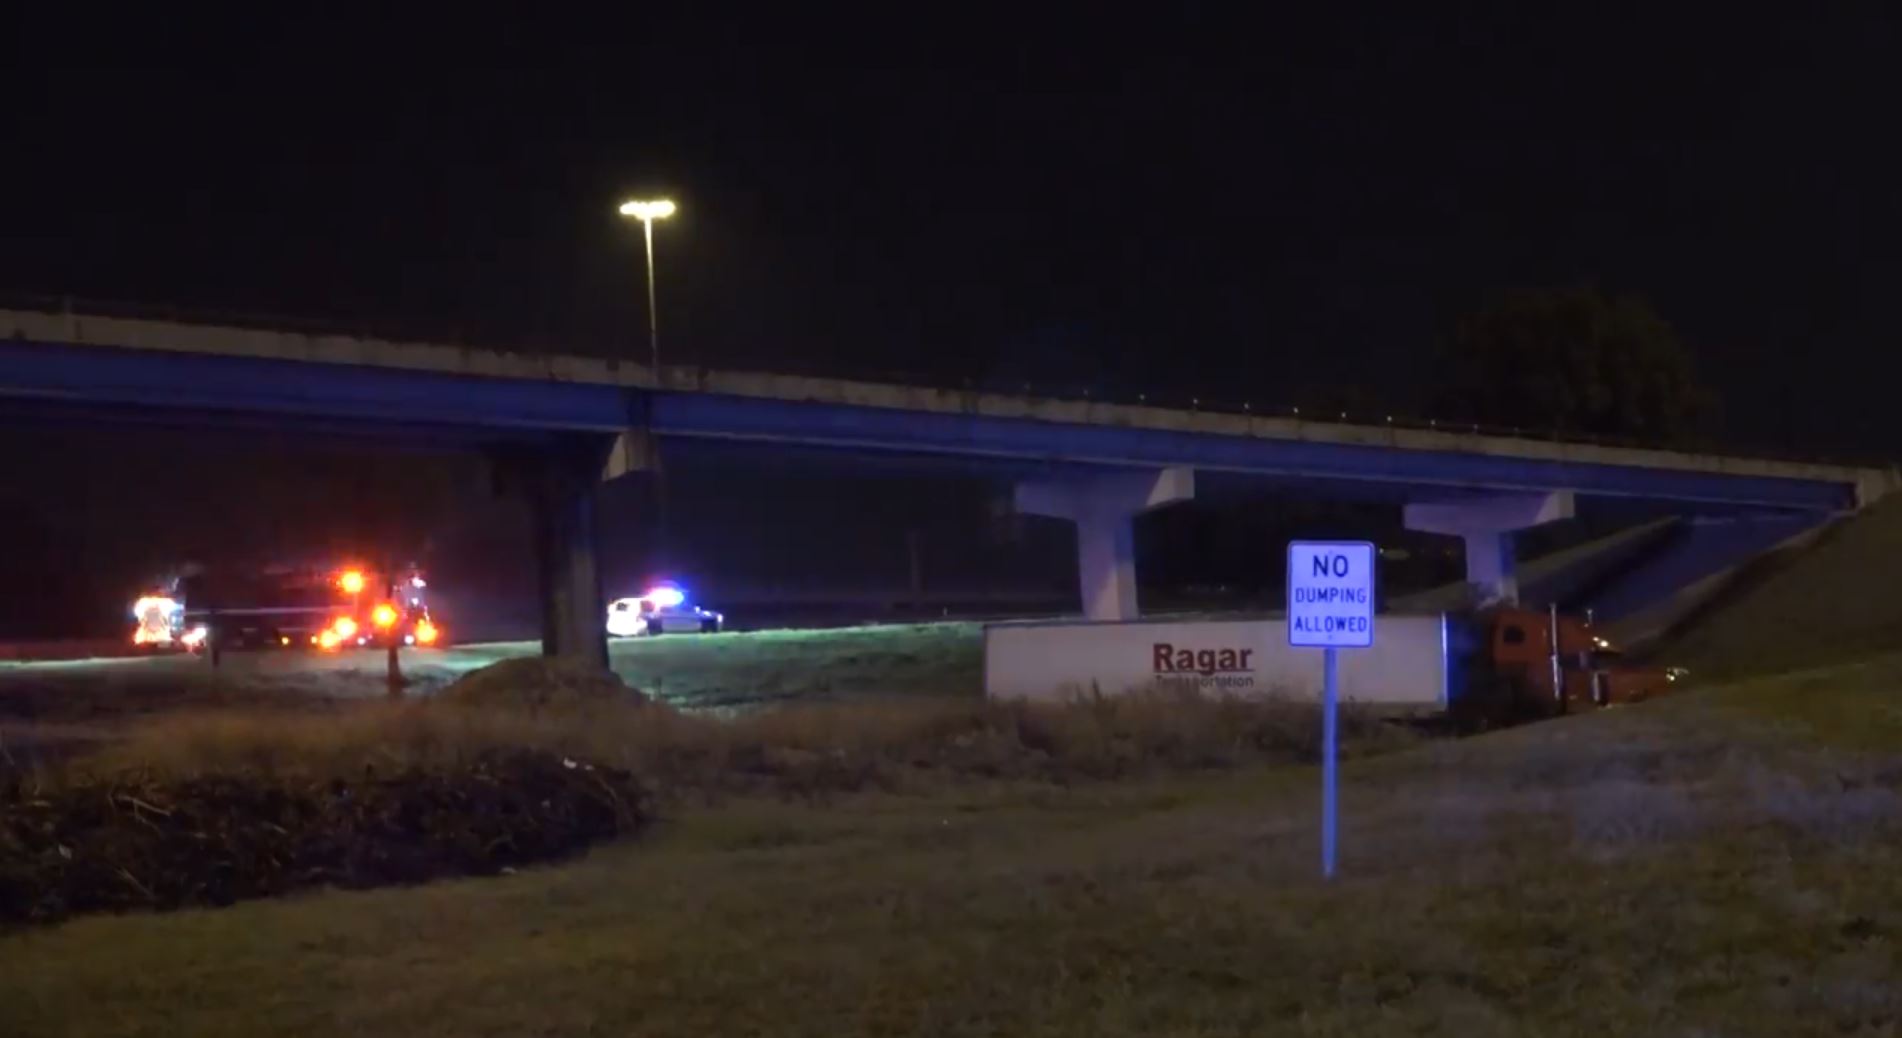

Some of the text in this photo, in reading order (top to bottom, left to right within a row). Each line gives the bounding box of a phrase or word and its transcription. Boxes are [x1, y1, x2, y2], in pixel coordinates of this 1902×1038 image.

[1313, 555, 1348, 578] NO
[1295, 587, 1367, 603] DUMPING
[1295, 615, 1367, 632] ALLOWED
[1153, 643, 1253, 676] Ragar
[1154, 675, 1254, 688] Tortation
